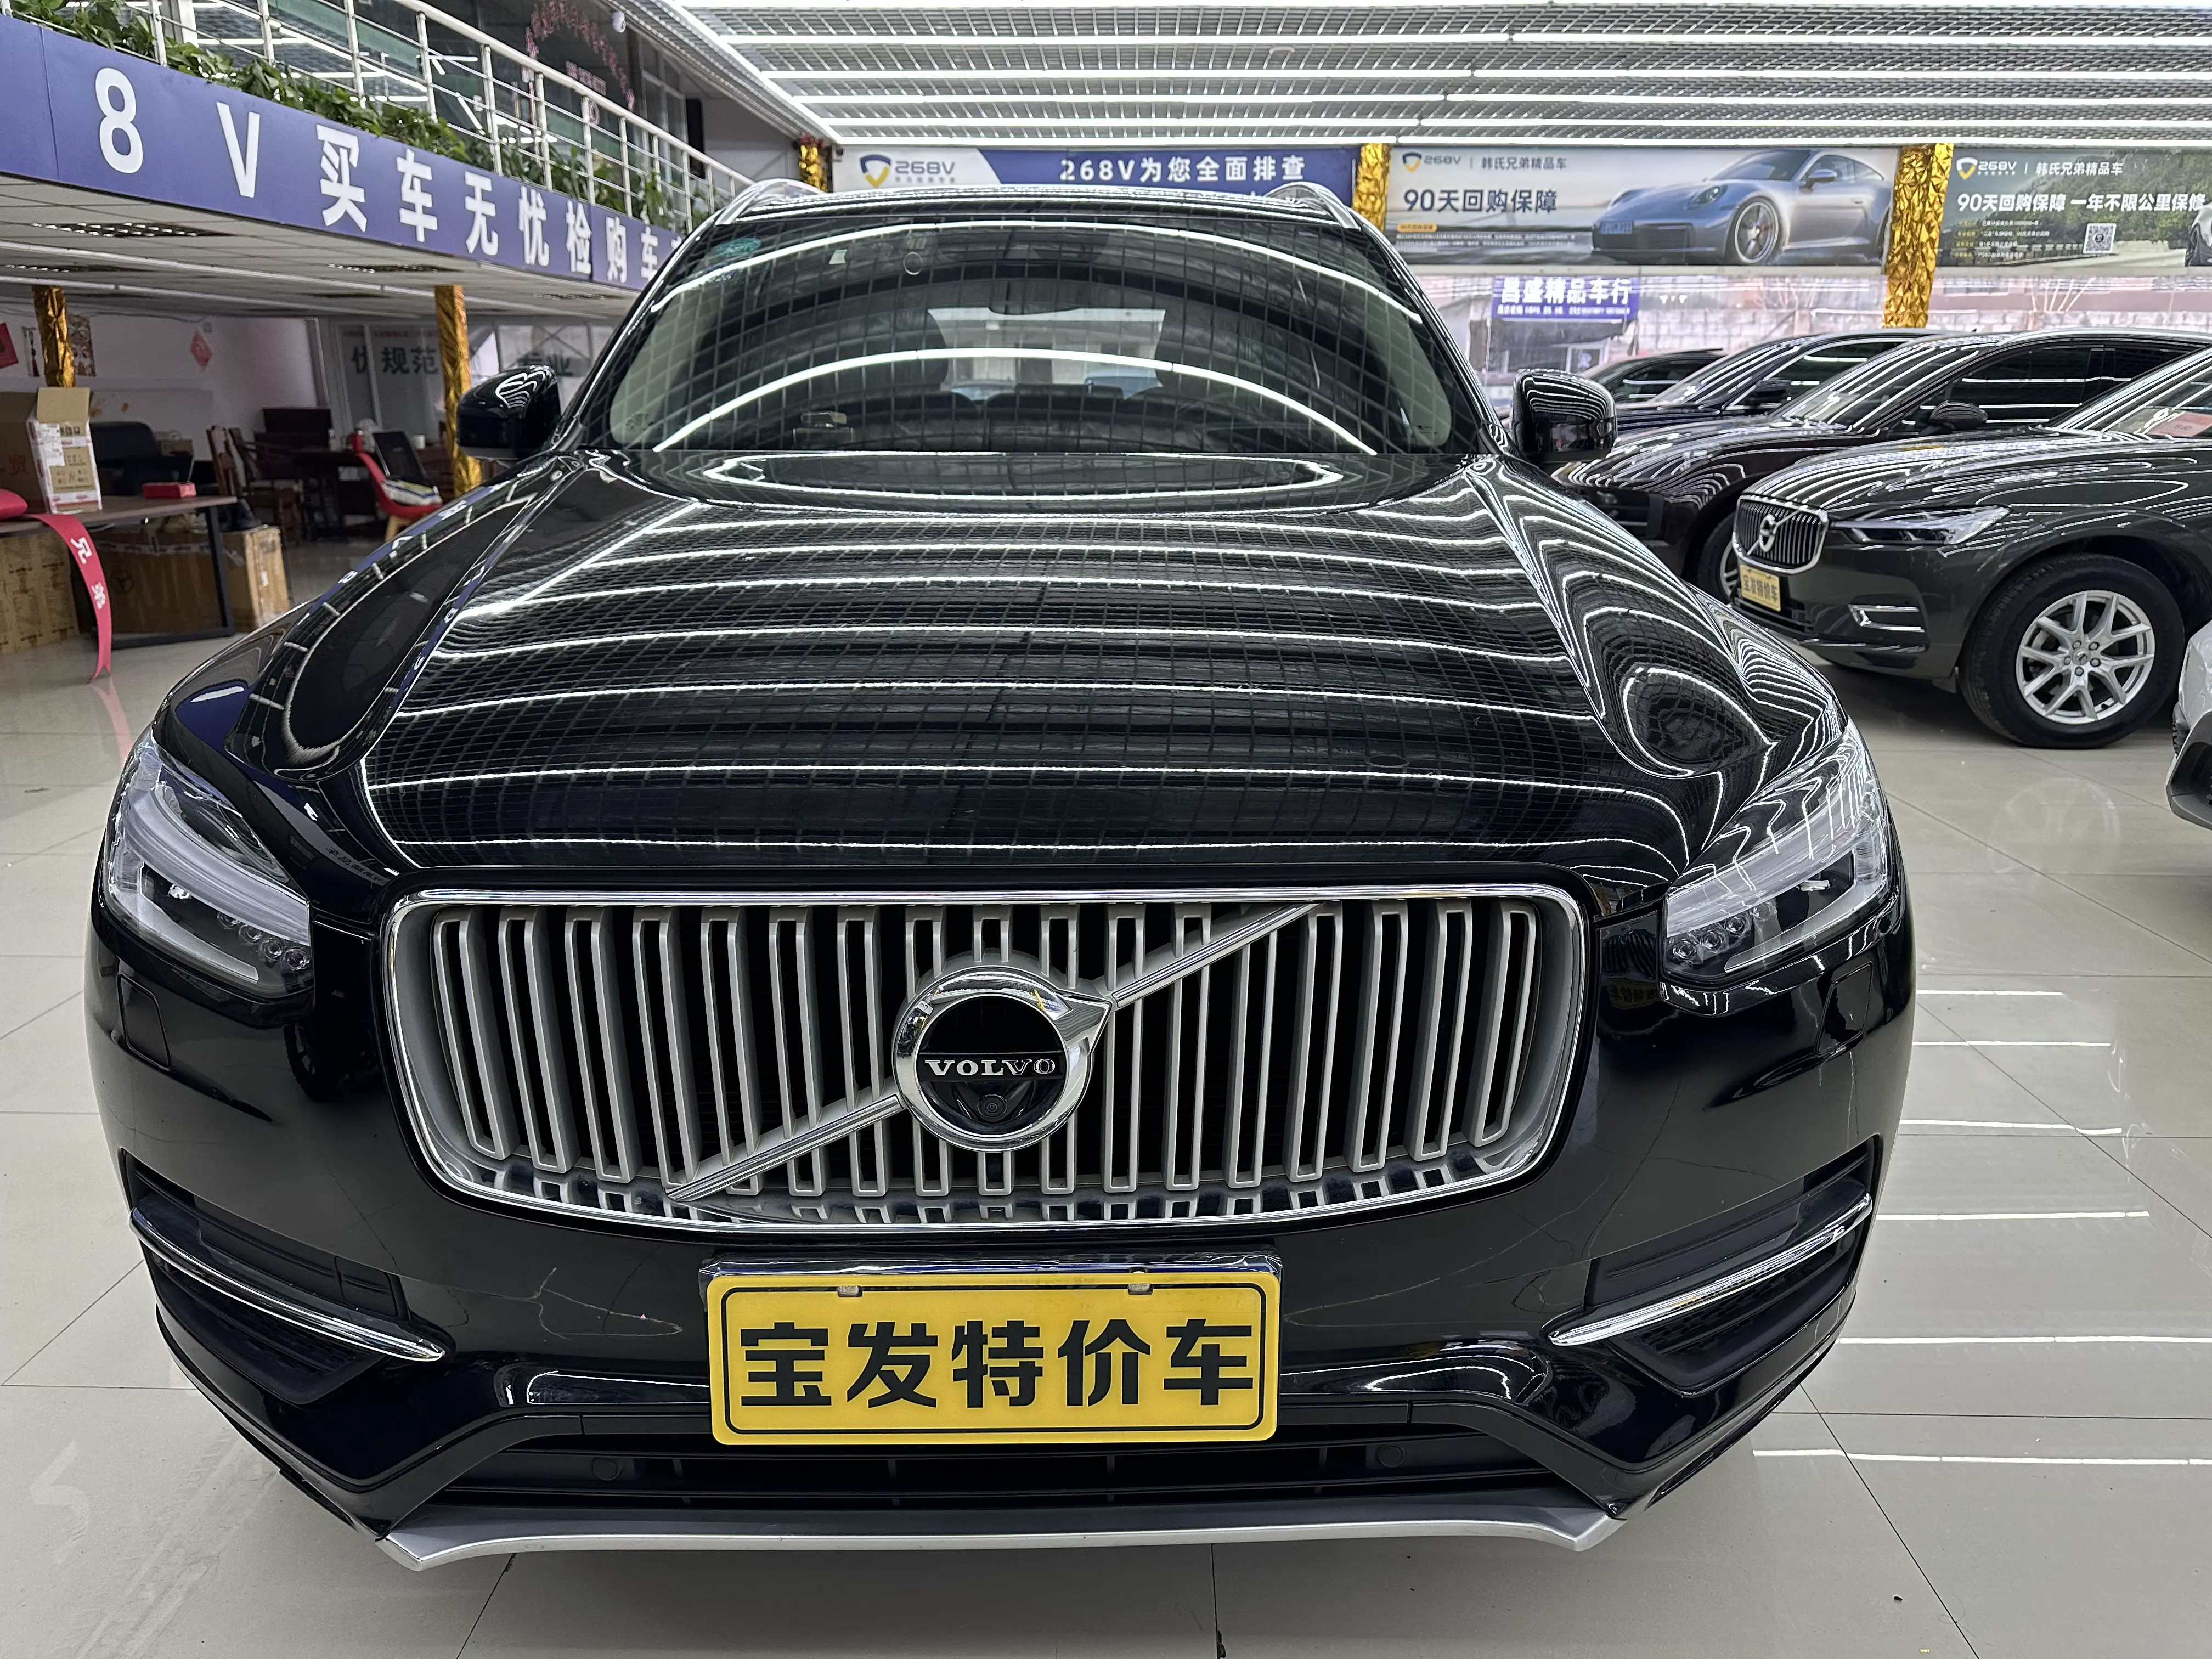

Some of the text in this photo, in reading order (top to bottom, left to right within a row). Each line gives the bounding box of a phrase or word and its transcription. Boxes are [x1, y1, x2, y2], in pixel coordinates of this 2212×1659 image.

[895, 161, 956, 174] 268V
[1059, 154, 1305, 183] 268V为您全面排查
[1977, 161, 2124, 176] 268V 韩氏兄弟精品车
[1403, 188, 1558, 213] 90天回购保障
[1957, 193, 2067, 212] 90天回购保障
[924, 1058, 1056, 1076] VOLVO
[740, 1318, 1254, 1408] 宝发特价车
